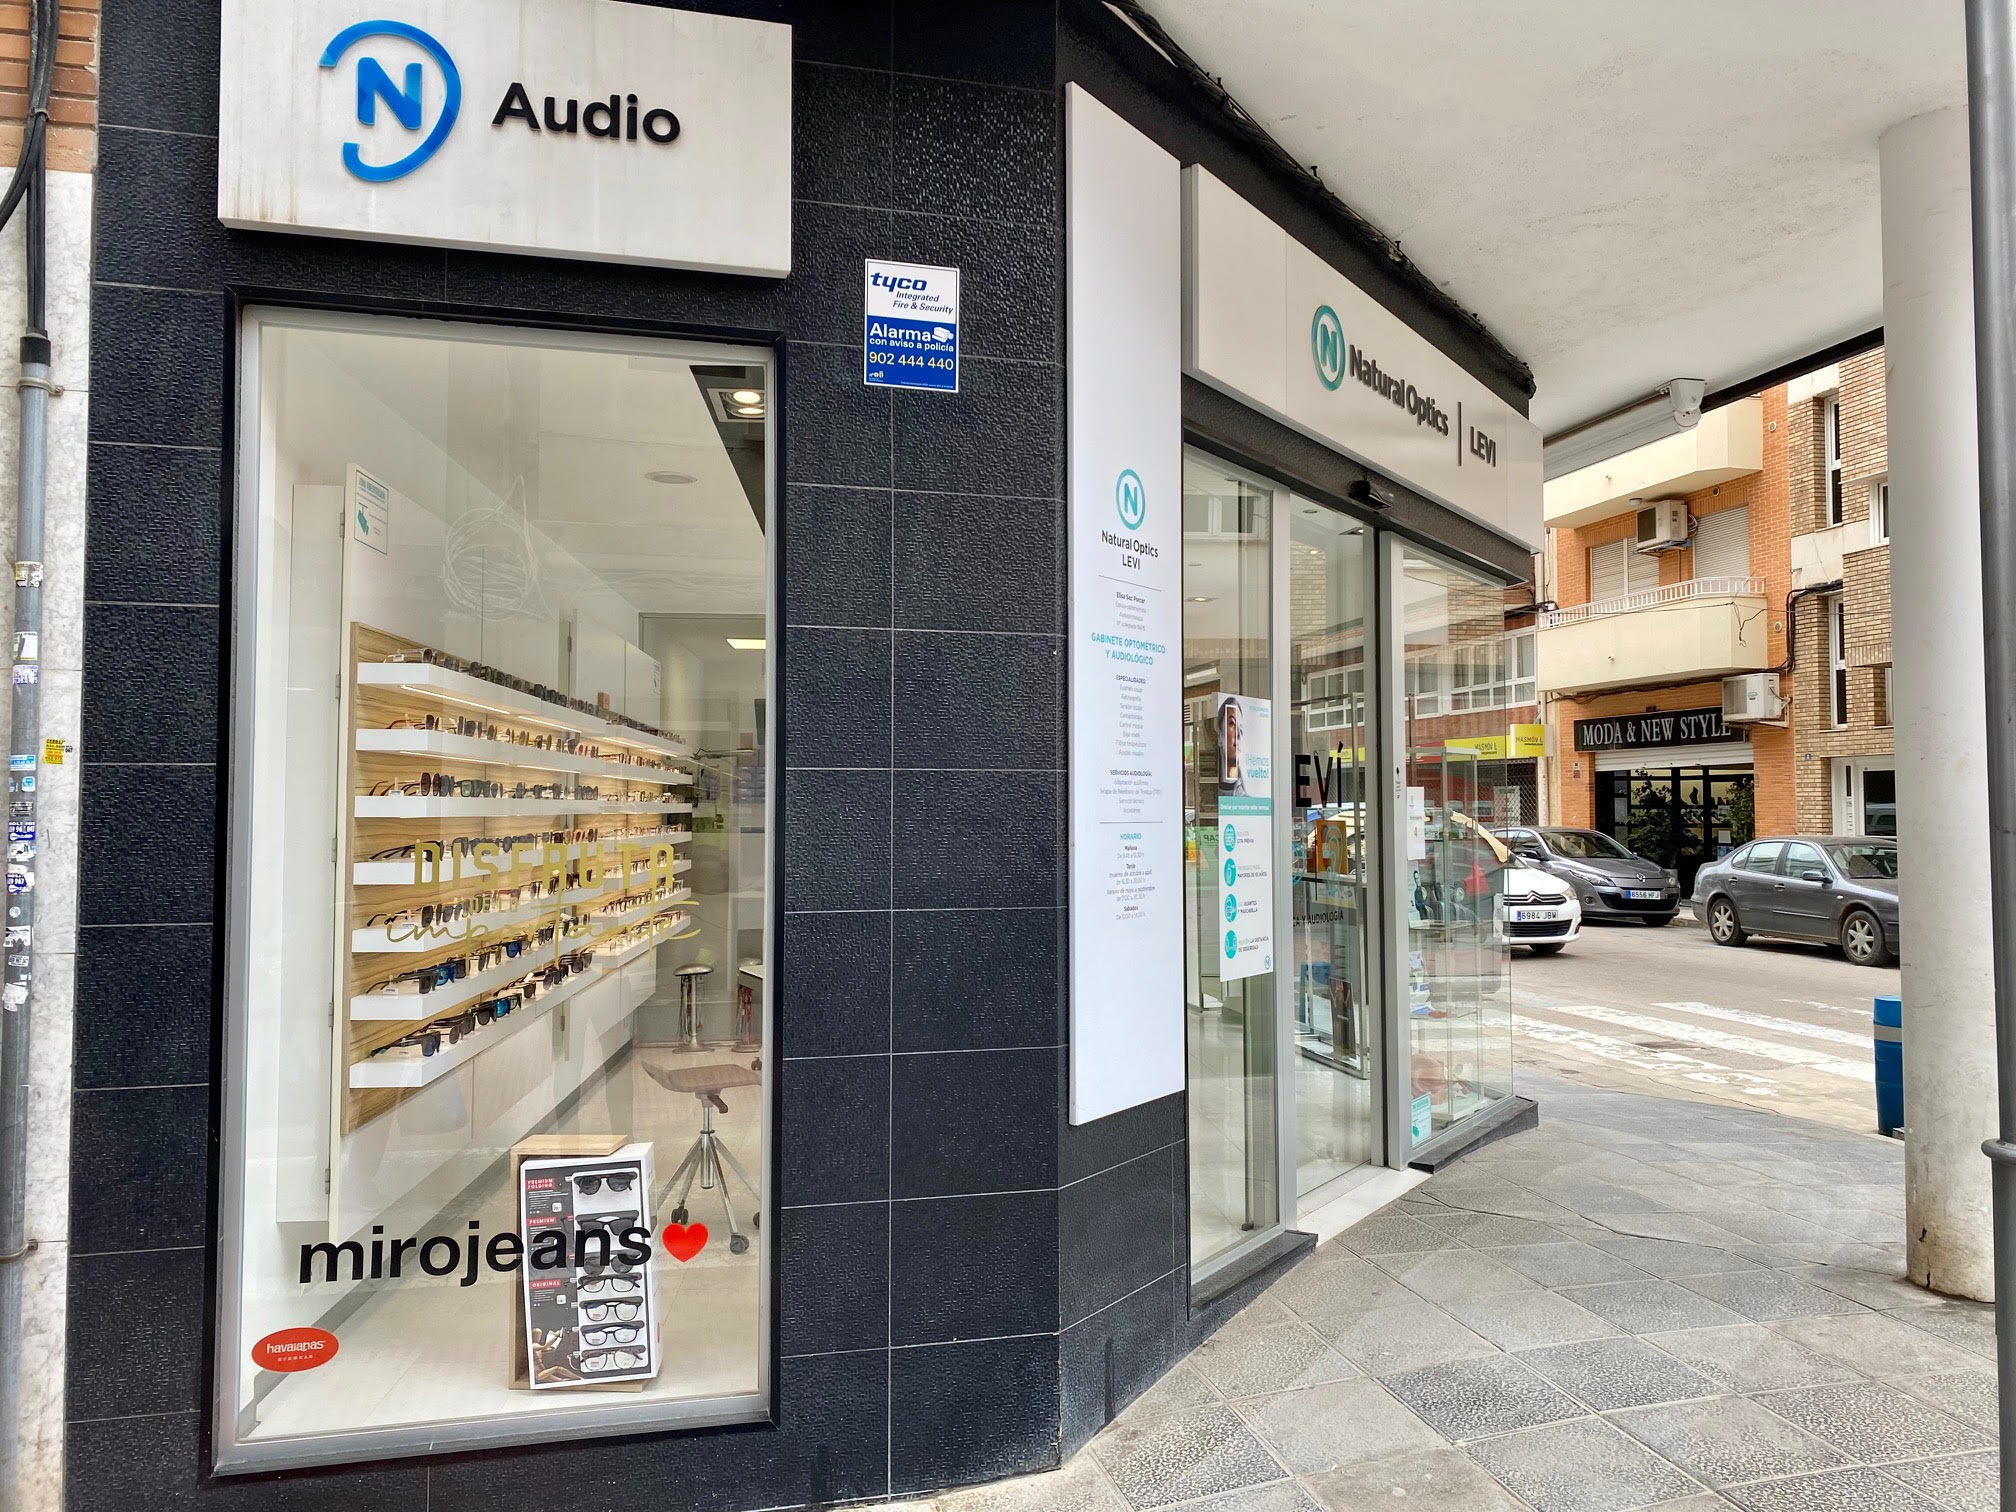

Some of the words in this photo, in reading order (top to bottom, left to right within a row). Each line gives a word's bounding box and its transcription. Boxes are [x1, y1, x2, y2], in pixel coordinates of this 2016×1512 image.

[492, 82, 681, 144] Audio
[870, 272, 927, 292] tyco
[896, 291, 940, 302] Integrated
[892, 300, 909, 309] Fire
[919, 304, 954, 315] Security
[870, 322, 931, 342] Alarma
[869, 338, 887, 346] con
[889, 340, 915, 348] aviso
[924, 341, 954, 352] policía
[869, 351, 895, 365] 902
[898, 354, 924, 368] 444
[927, 357, 954, 371] 440
[1349, 344, 1405, 409] Natural
[1405, 385, 1449, 436] Optics
[1470, 426, 1496, 467] LEVI
[1101, 530, 1132, 550] Natural
[1133, 539, 1159, 558] Optics
[1122, 554, 1141, 570] LEVI
[1091, 632, 1123, 646] GABINETE
[1105, 649, 1110, 659] Y
[1583, 722, 1623, 746] MODA
[1626, 721, 1636, 742] &
[1641, 718, 1674, 742] NEW
[414, 842, 674, 889] DISFRUTA
[299, 1220, 652, 1287] mirojeans
[266, 1340, 325, 1354] havaianas
